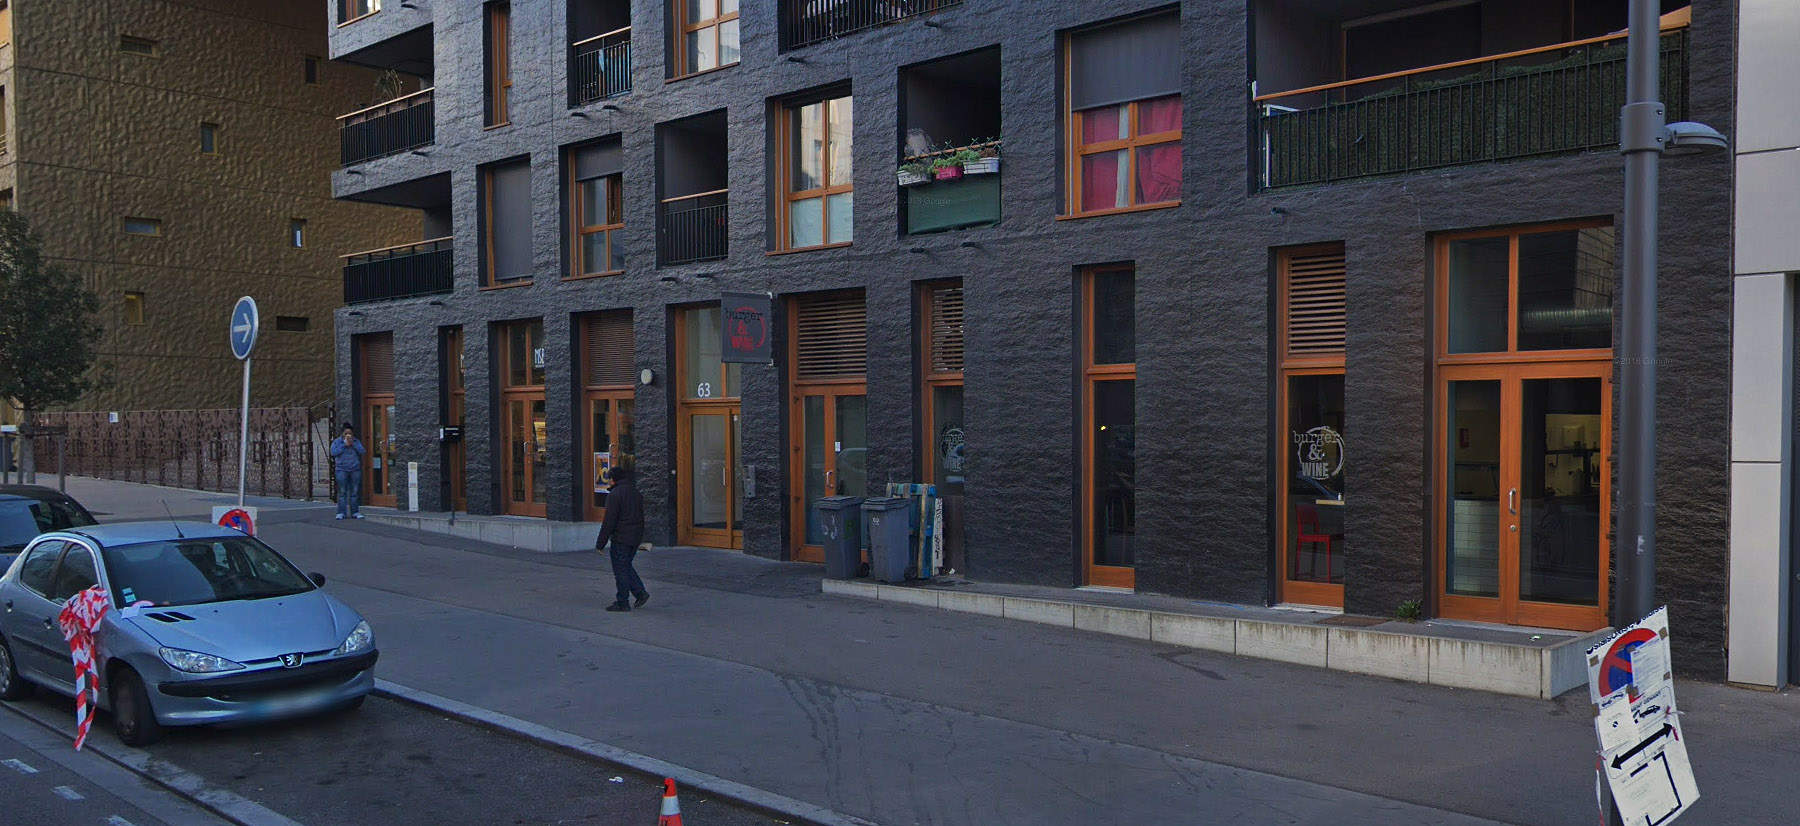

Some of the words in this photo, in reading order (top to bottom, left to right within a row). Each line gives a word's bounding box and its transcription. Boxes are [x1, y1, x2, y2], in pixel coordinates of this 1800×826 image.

[725, 308, 763, 324] burger
[697, 382, 711, 398] 63
[1293, 431, 1341, 447] burger
[1307, 443, 1323, 461] &
[1301, 462, 1329, 477] WINE
